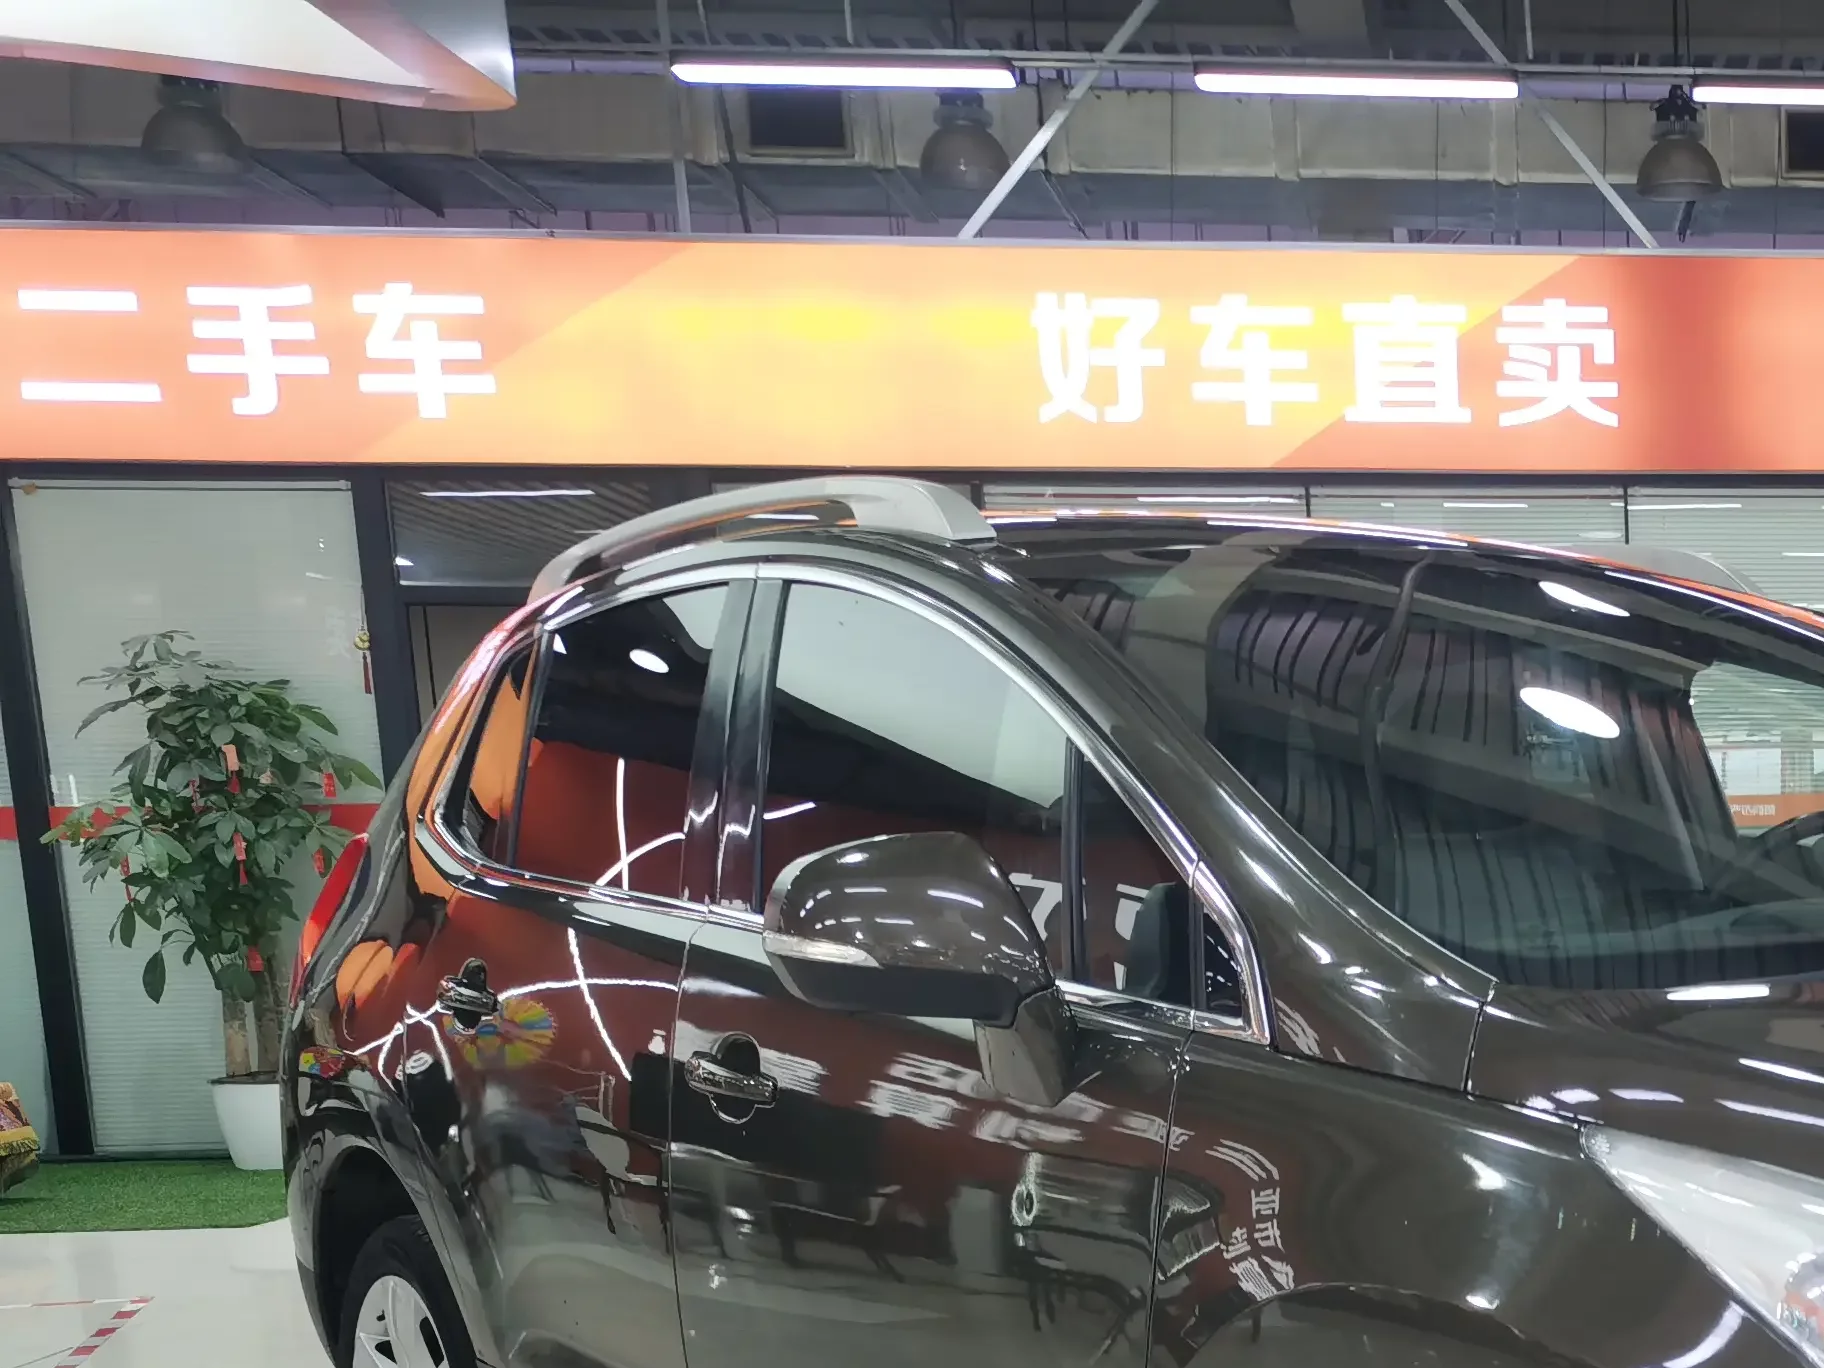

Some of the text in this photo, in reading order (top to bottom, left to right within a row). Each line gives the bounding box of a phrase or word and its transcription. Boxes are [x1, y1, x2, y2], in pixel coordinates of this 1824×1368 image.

[17, 281, 497, 419] 二手车
[1029, 291, 1621, 428] 好车直卖
